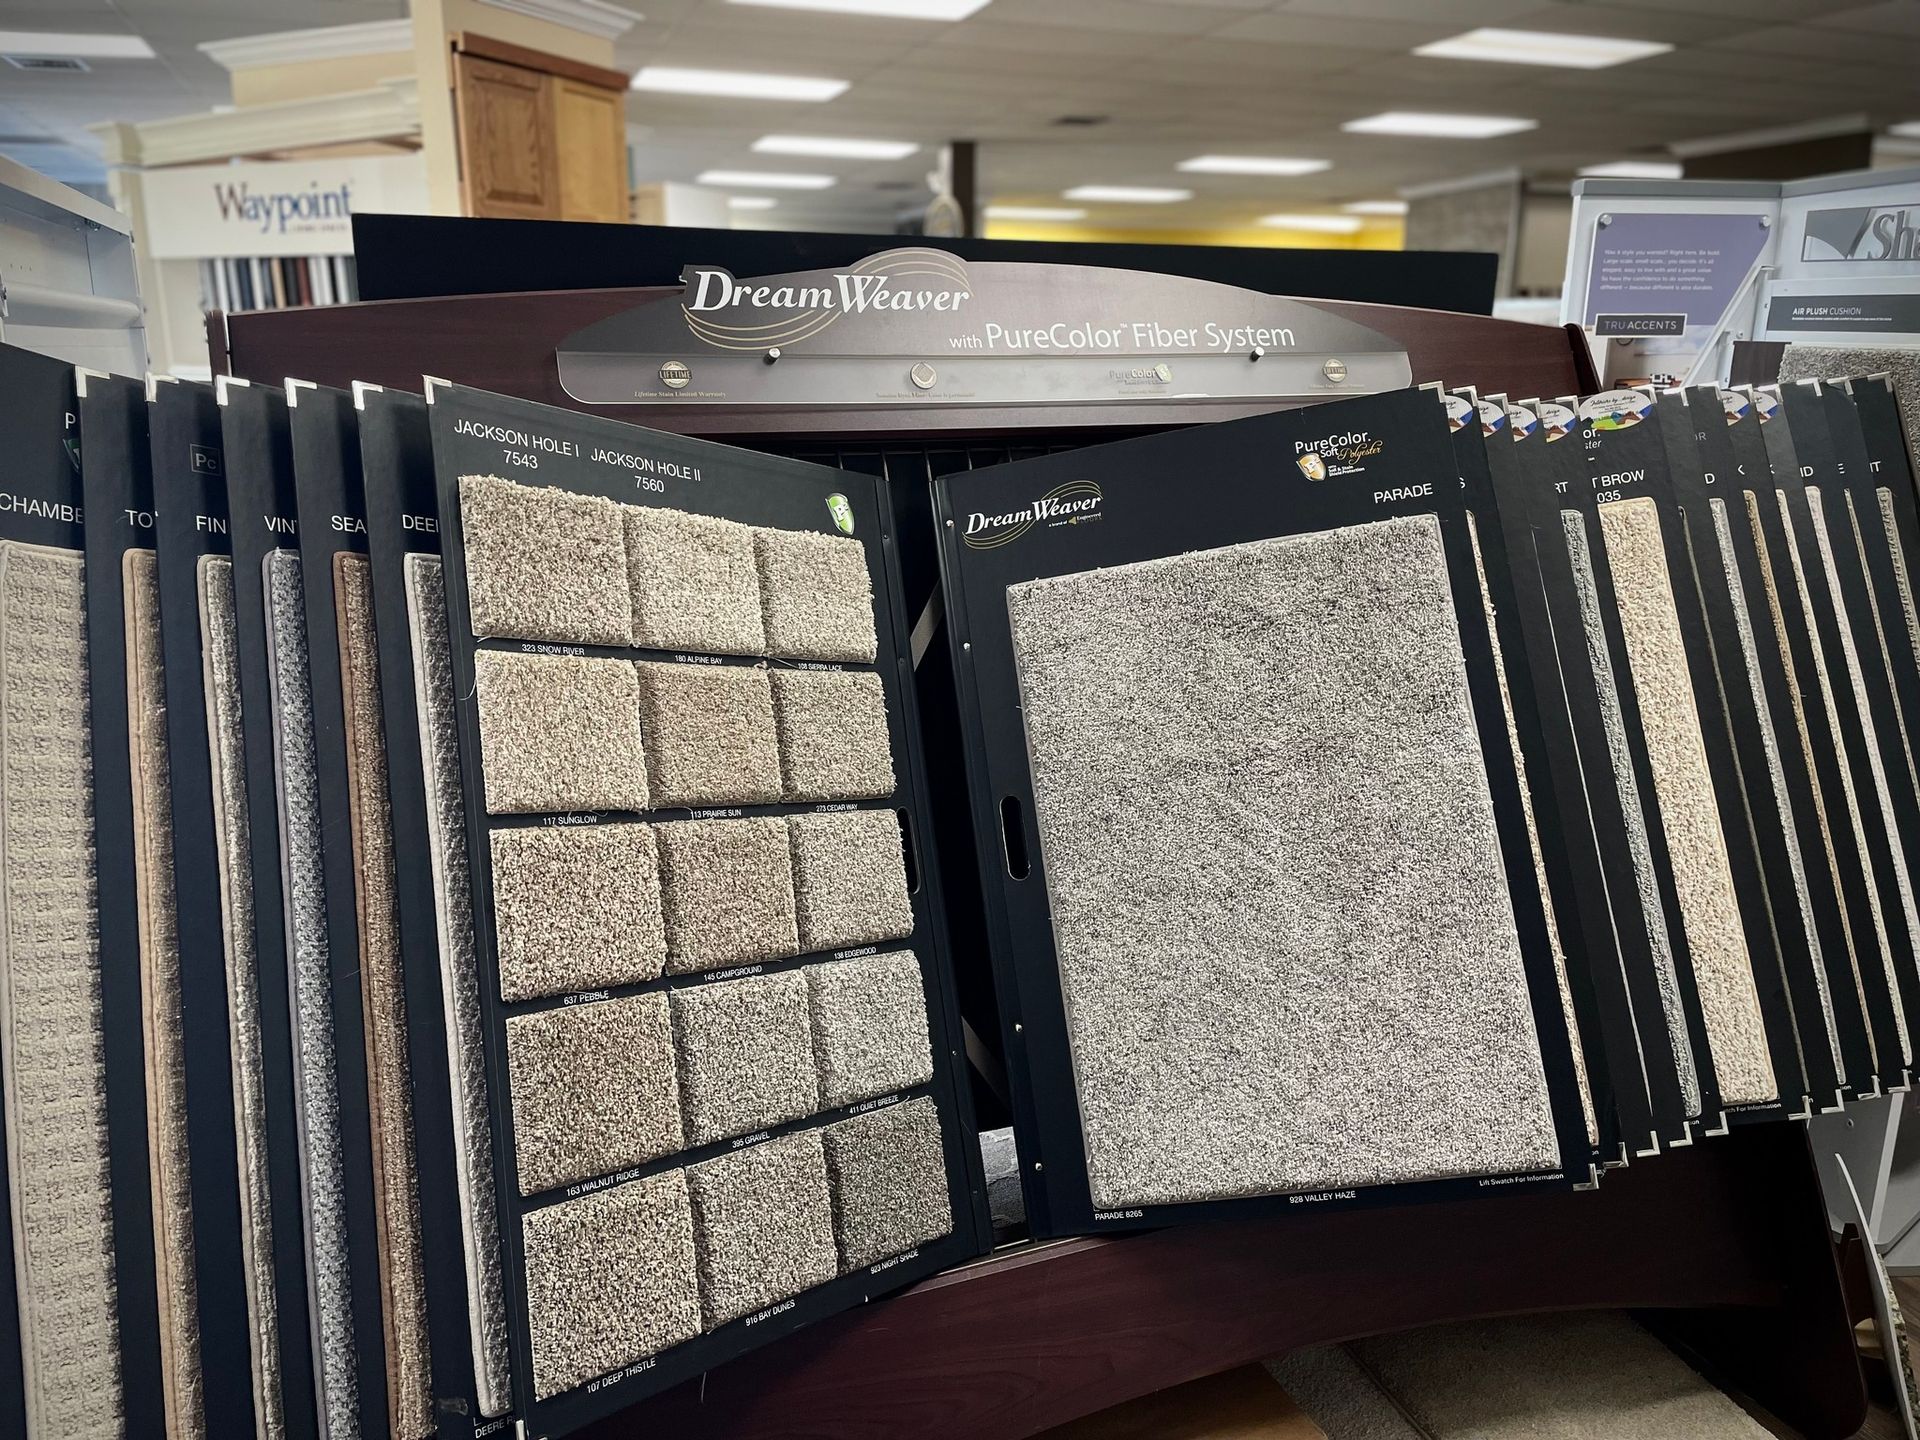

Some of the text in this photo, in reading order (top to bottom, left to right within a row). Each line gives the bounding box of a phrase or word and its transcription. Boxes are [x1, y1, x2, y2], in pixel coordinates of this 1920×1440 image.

[214, 181, 351, 234] Waypoint
[1867, 209, 1920, 261] Sh
[1792, 306, 1862, 316] AIR PLUSH CUSHION
[1605, 320, 1677, 330] TRU ACCENTS
[949, 334, 983, 349] with
[1134, 322, 1199, 348] Fiber
[1204, 322, 1296, 354] System
[659, 370, 692, 379] LIFETIME
[454, 419, 529, 448] JACKSON
[532, 436, 573, 457] HOLE
[503, 450, 539, 469] 7543
[1320, 440, 1384, 465] Soft Polyester
[591, 449, 654, 473] JACKSON
[657, 461, 692, 480] HOLE
[634, 476, 665, 493] 7560
[1601, 469, 1645, 487] BROW
[1374, 483, 1434, 503] PARADE
[522, 644, 585, 655] 323 SNOW RIVER
[687, 655, 709, 664] ALPINE
[710, 656, 723, 664] BAY
[702, 808, 727, 818] PRAIRIE
[728, 809, 742, 817] SUN
[826, 803, 846, 812] CEDAR
[846, 803, 858, 811] WAY
[557, 815, 597, 825] SUNGLOW
[845, 946, 877, 958] EDGEWOOD
[716, 964, 763, 980] CAMPGROUND
[564, 990, 609, 1005] 637 PEBBLE
[877, 1094, 899, 1107] BREEZE
[745, 1131, 771, 1145] GRAVEL
[566, 1168, 640, 1197] 163 WALNUT RIDGE
[1490, 1177, 1514, 1186] Swatch
[1526, 1173, 1564, 1181] Information
[1304, 1192, 1333, 1202] VALLEY
[1334, 1190, 1357, 1199] HAZE
[1094, 1211, 1125, 1220] PARADE
[881, 1256, 900, 1270] NIGHT
[899, 1248, 919, 1263] SHADE
[745, 1299, 796, 1327] 916 BAY DUNES
[586, 1357, 657, 1394] 107 DEEP THISTLE
[475, 1420, 505, 1439] DEERE
